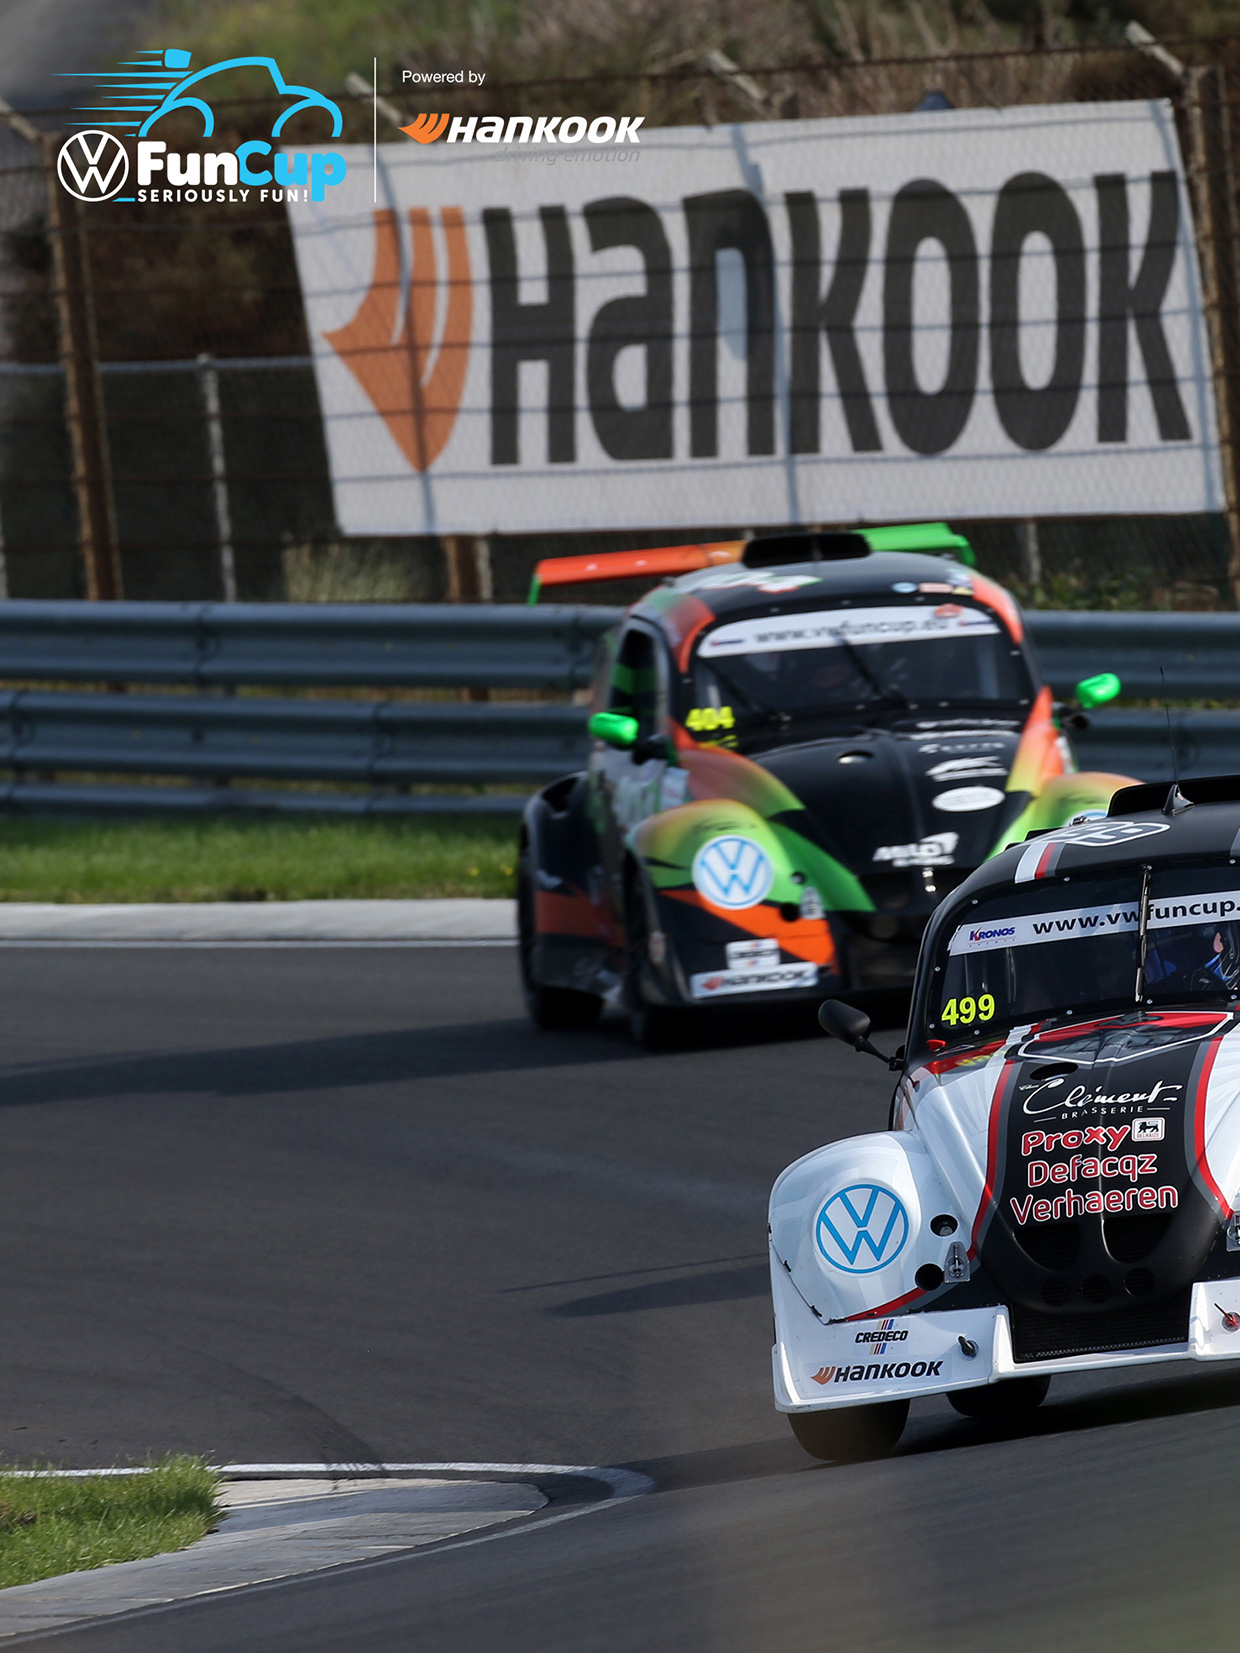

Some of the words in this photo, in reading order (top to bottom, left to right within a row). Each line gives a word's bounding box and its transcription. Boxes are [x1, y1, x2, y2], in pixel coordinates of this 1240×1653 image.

[969, 927, 1016, 941] KRONOS
[941, 993, 995, 1025] 499
[1061, 1106, 1144, 1120] BRASSERIE
[1021, 1125, 1130, 1156] Proxy
[1027, 1154, 1158, 1188] Defacqz
[1010, 1185, 1178, 1225] Verhaeren
[855, 1330, 909, 1344] CREDECO
